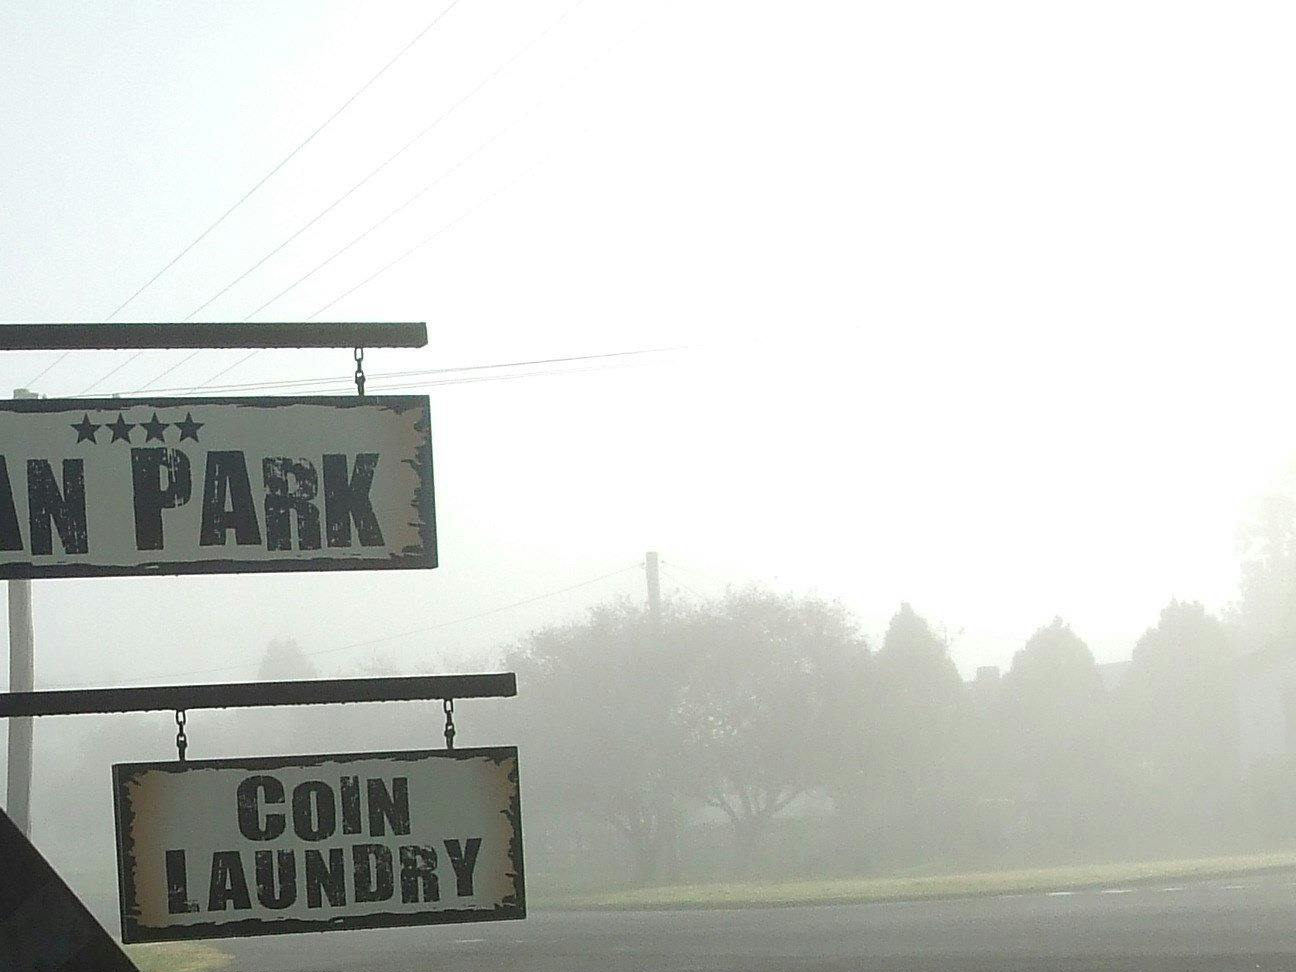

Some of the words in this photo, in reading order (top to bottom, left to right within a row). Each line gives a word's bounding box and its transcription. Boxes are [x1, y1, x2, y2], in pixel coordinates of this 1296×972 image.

[130, 447, 385, 551] PARK
[236, 775, 412, 842] COIN
[165, 837, 482, 914] LAUNDRY
